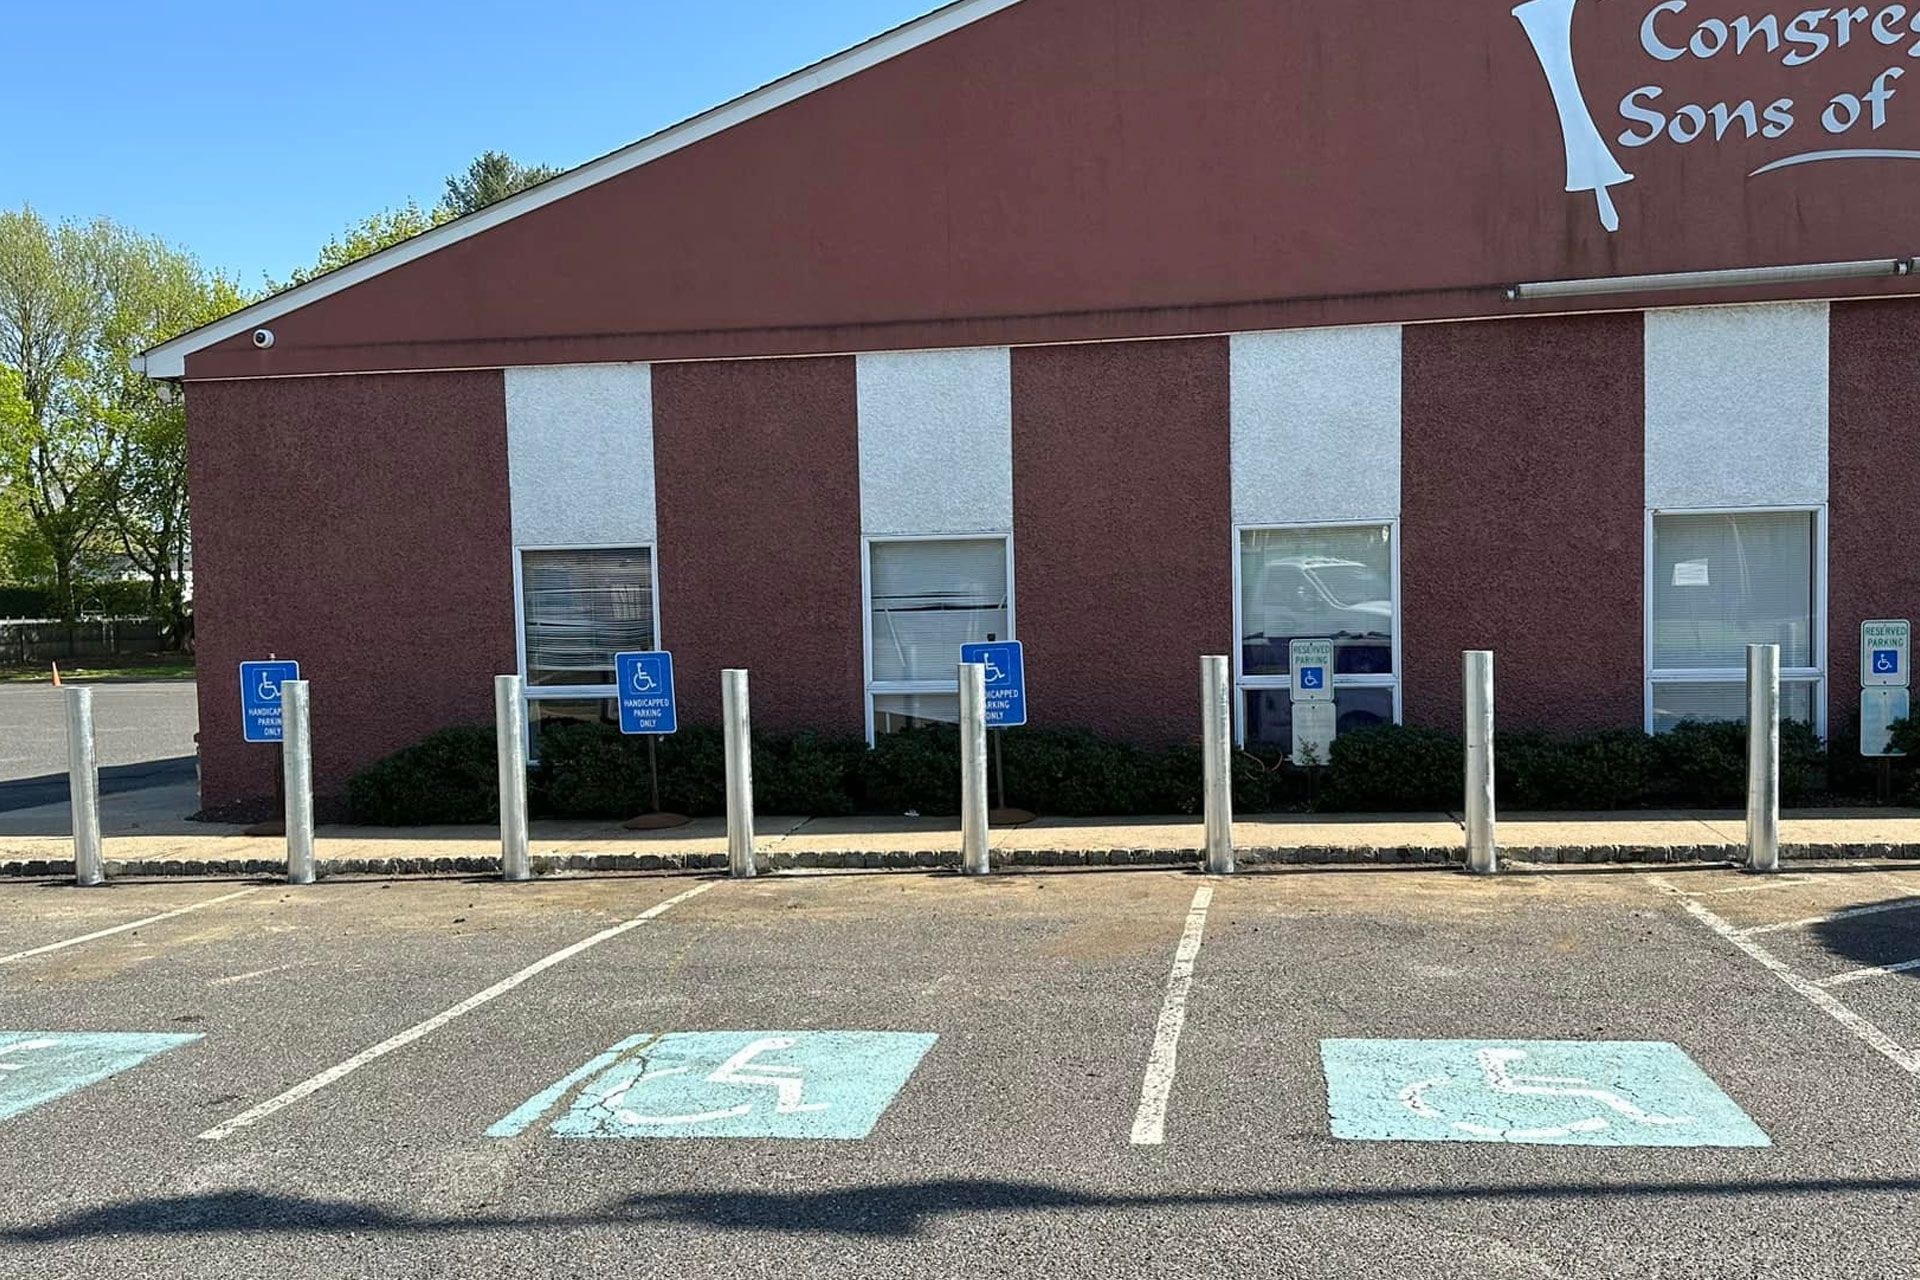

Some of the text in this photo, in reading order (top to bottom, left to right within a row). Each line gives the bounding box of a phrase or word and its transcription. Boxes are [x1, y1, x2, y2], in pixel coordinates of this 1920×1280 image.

[1640, 0, 1920, 66] Congre
[1617, 67, 1905, 147] Sons of
[1865, 627, 1907, 636] RESERVED
[1867, 638, 1904, 648] PARKING
[1293, 645, 1330, 654] RESERVED
[1295, 655, 1328, 665] PARKING
[624, 699, 670, 707] HANDICAPPED
[249, 708, 282, 716] HANDICAP
[633, 709, 662, 717] PARKING
[986, 711, 1004, 720] ONLY
[258, 718, 282, 726] PARKIN
[640, 719, 657, 727] ONLY
